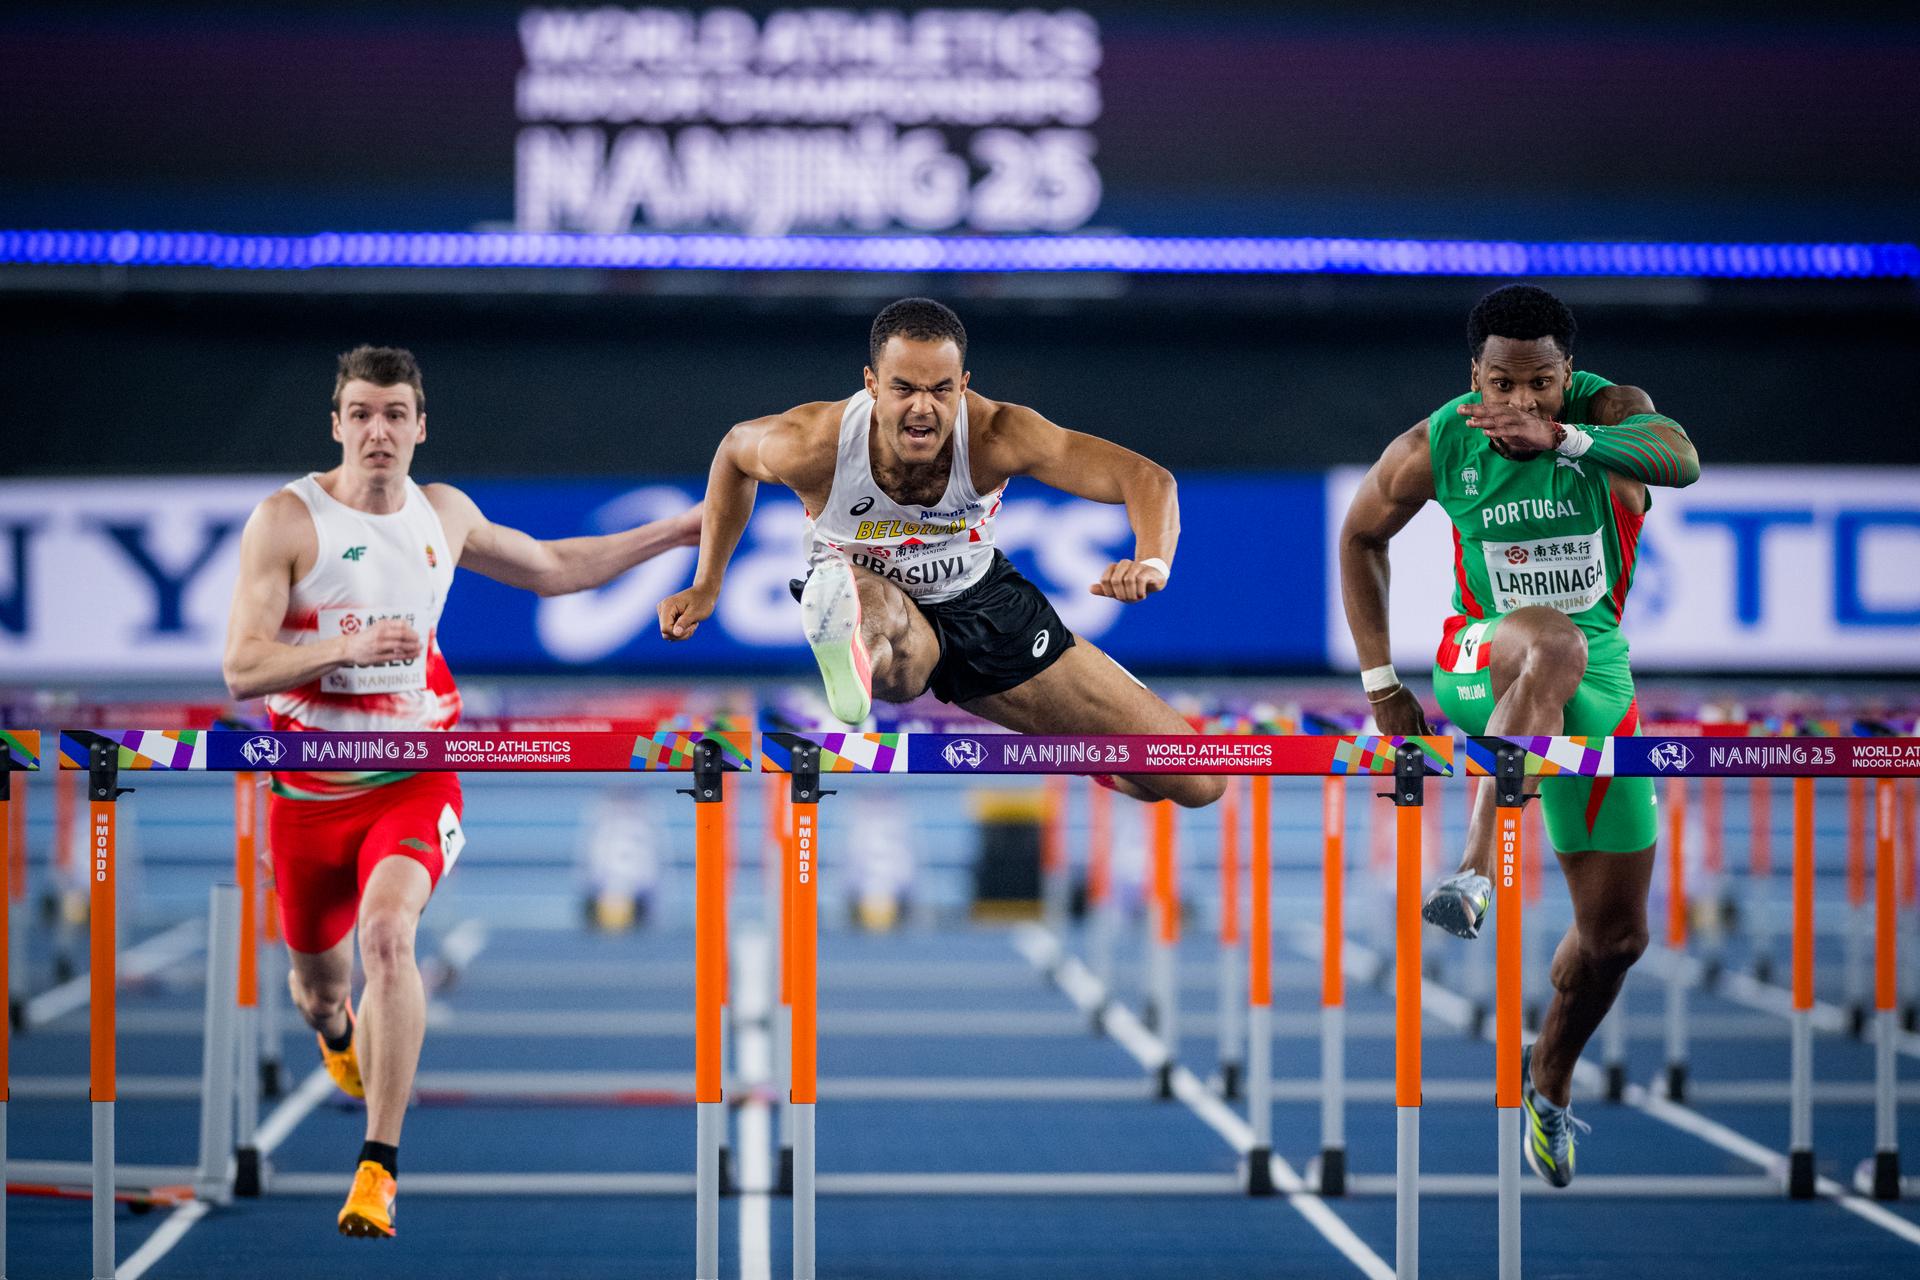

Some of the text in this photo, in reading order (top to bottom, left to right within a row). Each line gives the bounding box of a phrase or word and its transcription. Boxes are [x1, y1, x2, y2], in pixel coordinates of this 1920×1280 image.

[515, 116, 1103, 236] NANJING 25
[1482, 499, 1581, 529] PORTUGAL
[1533, 541, 1591, 557] 南京银行
[852, 553, 964, 585] OBASUYI
[1495, 559, 1603, 596] LARRINAGA
[1456, 682, 1486, 701] PORTUGAL
[302, 739, 428, 763] NANJING 25
[445, 741, 571, 752] WORLD ATHLETICS
[445, 754, 571, 763] INDOOR CHAMPIONSHIPS
[1003, 742, 1130, 767] NANJING 25
[1147, 744, 1272, 756] WORLD ATHLETICS
[1710, 744, 1836, 768] NANJING 25
[1852, 745, 1902, 757] WORLD
[1146, 757, 1272, 766] INDOOR CHAMPIONSHIPS
[1852, 759, 1892, 768] INDOOR
[96, 826, 108, 881] MONDO
[799, 828, 811, 884] MONDO
[1503, 831, 1515, 887] MONDO
